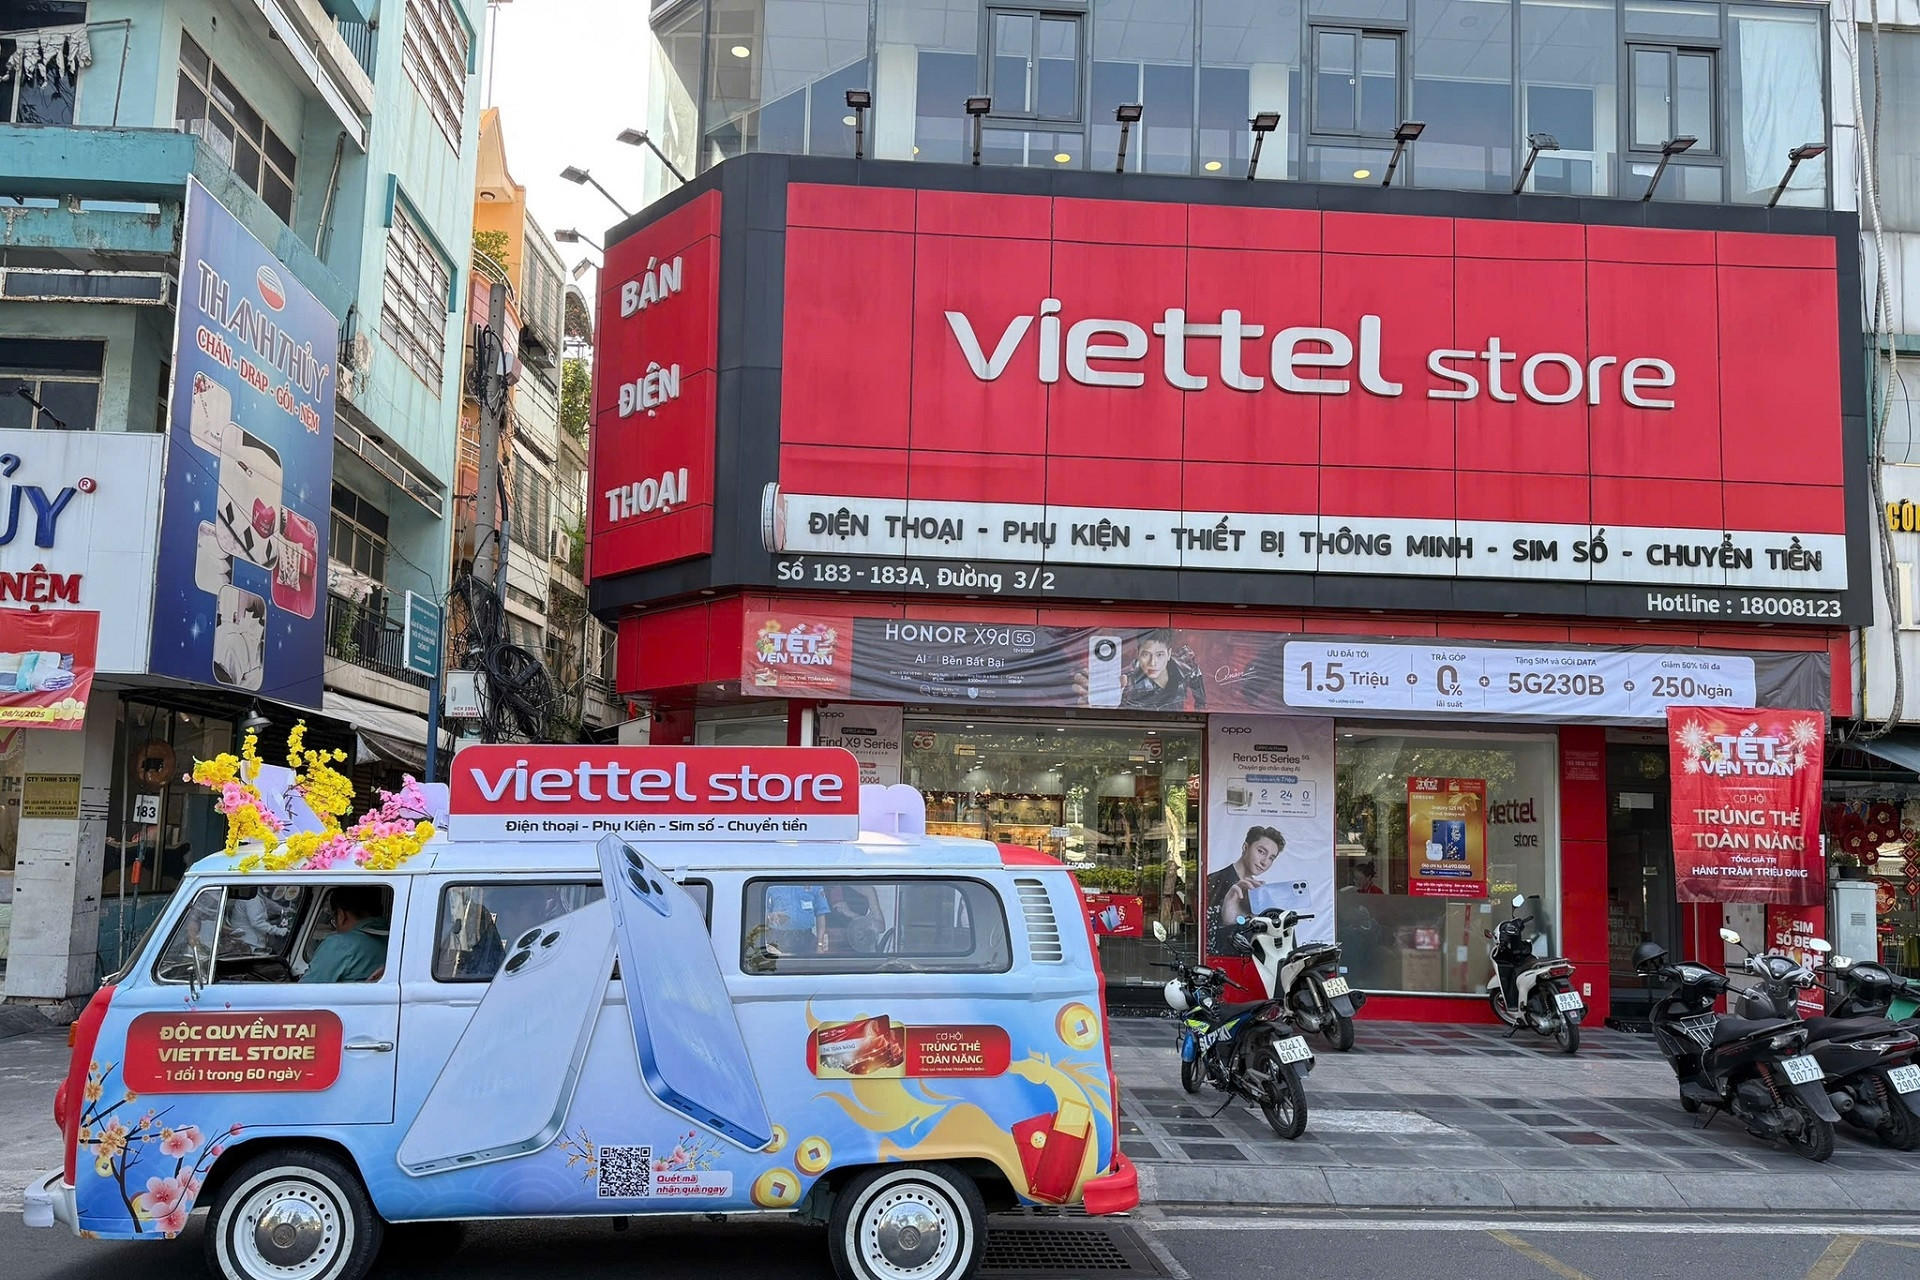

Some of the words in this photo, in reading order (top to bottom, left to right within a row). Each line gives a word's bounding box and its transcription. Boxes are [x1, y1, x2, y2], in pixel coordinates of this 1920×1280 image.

[620, 256, 683, 318] BÁN
[198, 259, 276, 365] THANH
[944, 297, 1403, 397] viettel
[1427, 336, 1675, 411] store
[197, 327, 232, 369] CHĂN
[239, 356, 269, 396] DRAP
[276, 384, 294, 415] GỐI
[300, 403, 320, 435] NỆM
[618, 361, 680, 418] ĐIỆN
[605, 467, 689, 523] THOẠI
[809, 507, 869, 540] ĐIỆN
[885, 515, 963, 544] THOẠI
[1003, 520, 1056, 549] PHỤ
[1071, 518, 1130, 551] KIỆN
[1171, 515, 1246, 551] THIẾT
[1261, 531, 1284, 558] BỊ
[1300, 526, 1391, 556] THÔNG
[1407, 535, 1473, 559] MINH
[1512, 538, 1557, 562] SIM
[1572, 528, 1608, 563] SỐ
[1646, 534, 1753, 569] CHUYỂN
[1765, 536, 1822, 571] TIỀN
[777, 556, 804, 582] Số
[813, 564, 850, 582] 183
[870, 567, 929, 589] 183A,
[937, 564, 1002, 592] Đường
[1013, 571, 1055, 591] 3/2
[1647, 593, 1720, 613] Hotline
[1740, 596, 1842, 618] 18008123
[768, 623, 822, 653] TẾT
[885, 624, 967, 644] HONOR
[973, 628, 1010, 646] X9d
[1016, 634, 1031, 643] 5G
[756, 651, 788, 664] VẸN
[790, 650, 832, 666] TOÀN
[942, 655, 962, 666] Bền
[966, 657, 984, 667] Bất
[988, 658, 1005, 669] Bại
[1431, 653, 1446, 661] TRẢ
[1449, 652, 1466, 662] GÓP
[1515, 657, 1533, 666] Tặng
[1561, 657, 1575, 665] GÓI
[1661, 660, 1681, 669] Giảm
[1682, 661, 1698, 669] 50%
[1699, 661, 1709, 670] tối
[1301, 662, 1345, 692] 1.5
[1350, 671, 1389, 689] Triệu
[1508, 673, 1605, 696] 5G230B
[1652, 676, 1695, 698] 250
[1697, 683, 1733, 699] Ngàn
[820, 711, 844, 719] oppo
[819, 737, 842, 746] Find
[845, 738, 861, 748] X9
[864, 738, 898, 749] Series
[1714, 722, 1779, 761] TẾT
[1233, 753, 1268, 763] Reno15
[1270, 754, 1300, 764] Series
[1702, 761, 1741, 777] VẸN
[1743, 759, 1794, 776] TOÀN
[469, 760, 697, 802] viettel
[708, 766, 842, 802] store
[1261, 789, 1267, 798] 2
[1281, 790, 1292, 799] 24
[136, 805, 156, 818] 183
[1693, 805, 1765, 825] TRÚNG
[1769, 808, 1801, 827] THẺ
[505, 820, 538, 831] Điện
[542, 820, 578, 834] thoại
[592, 820, 619, 833] Phụ
[624, 819, 655, 833] Kiện
[669, 821, 694, 831] Sim
[698, 818, 714, 831] số
[728, 818, 779, 834] Chuyển
[783, 820, 807, 831] tiền
[1513, 833, 1538, 847] store
[1692, 829, 1749, 849] TOÀN
[1755, 827, 1804, 850] NĂNG
[1692, 866, 1718, 875] HÀNG
[1720, 866, 1752, 876] TRĂM
[1793, 921, 1813, 933] SIM
[1776, 928, 1791, 945] SỐ
[159, 1022, 201, 1043] ĐỘC
[206, 1017, 278, 1040] QUYỀN
[283, 1024, 316, 1041] TẠI
[920, 1041, 957, 1051] TRÚNG
[959, 1040, 981, 1051] THẺ
[158, 1047, 243, 1062] VIETTEL
[246, 1046, 315, 1060] STORE
[920, 1053, 950, 1064] TOÀN
[952, 1053, 983, 1064] NĂNG
[166, 1070, 171, 1080] 1
[174, 1067, 195, 1080] đổi
[198, 1069, 203, 1080] 1
[206, 1069, 243, 1082] trong
[246, 1069, 265, 1079] 60
[268, 1068, 302, 1081] ngày
[1791, 1068, 1820, 1082] 307.77
[657, 1175, 680, 1183] Quét
[657, 1186, 680, 1196] nhận
[682, 1186, 700, 1196] quà
